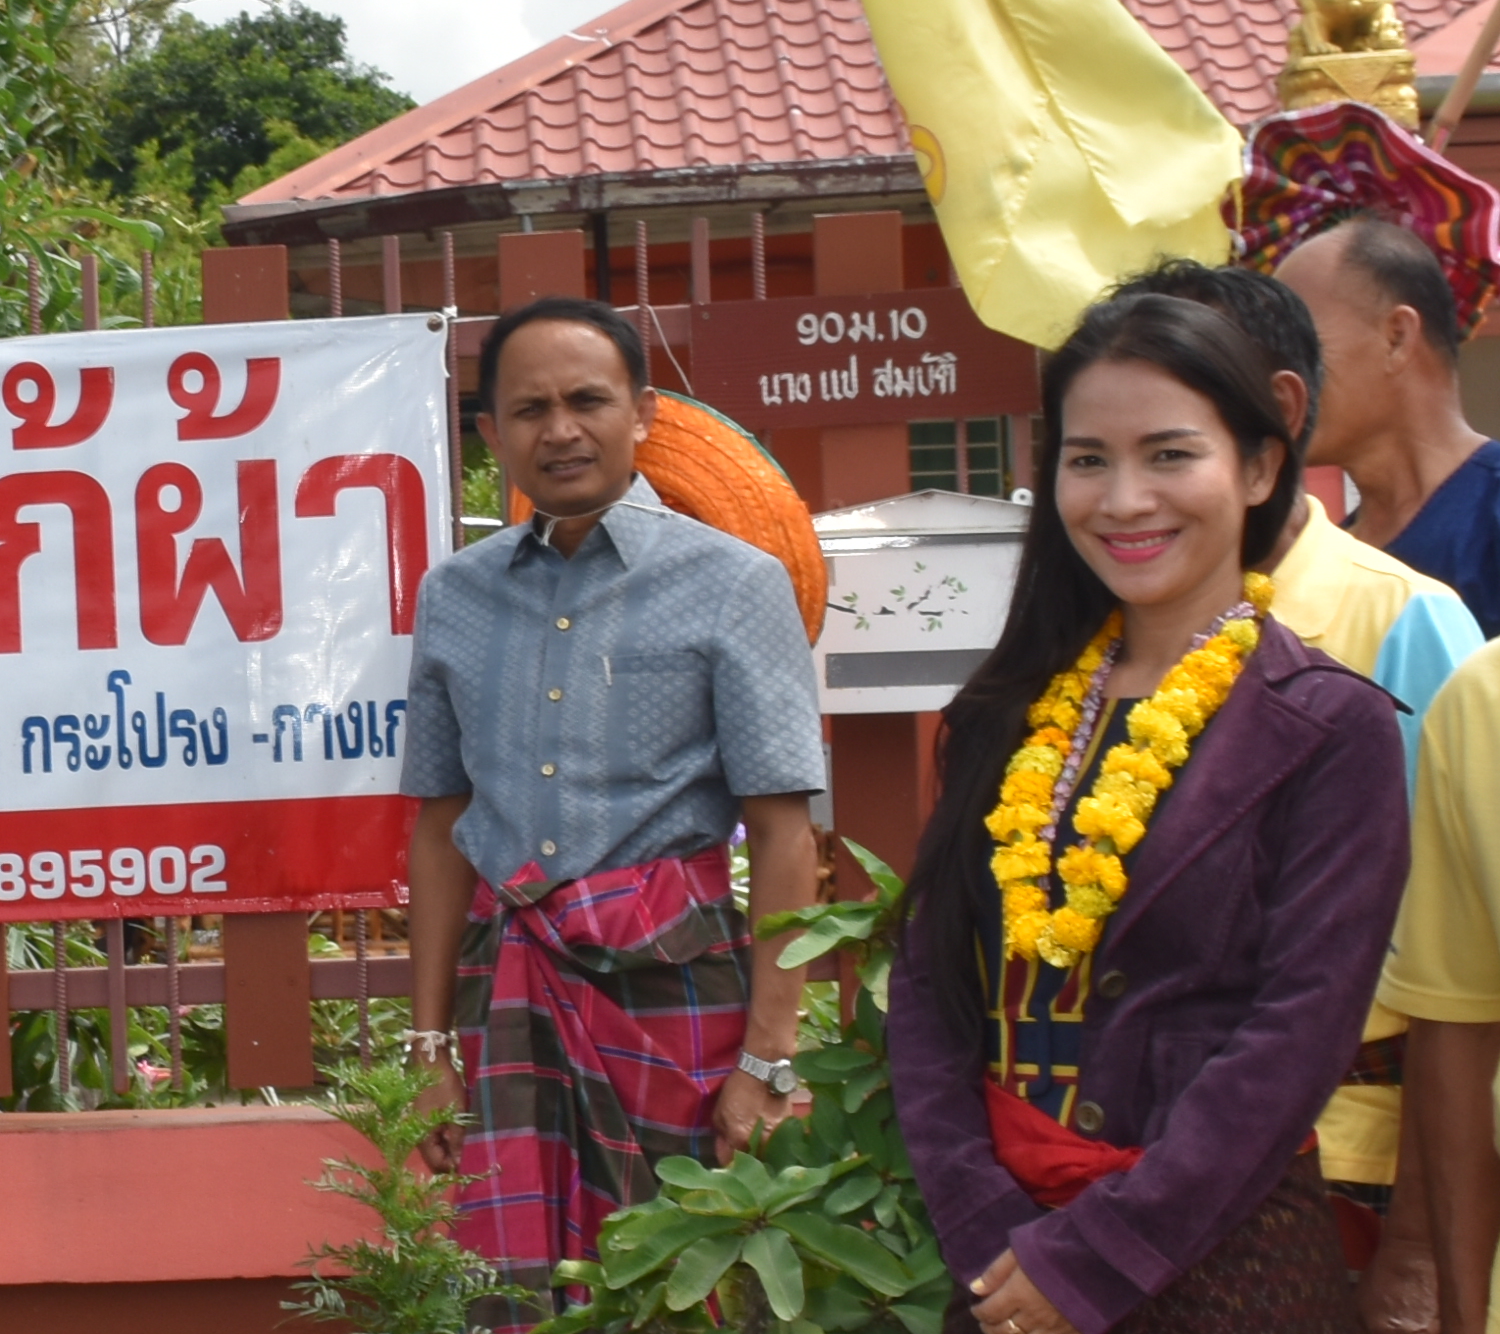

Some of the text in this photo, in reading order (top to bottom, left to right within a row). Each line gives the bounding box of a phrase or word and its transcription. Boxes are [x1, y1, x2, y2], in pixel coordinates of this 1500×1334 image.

[21, 669, 229, 774] กระโปรง
[252, 699, 407, 763] -กางเก
